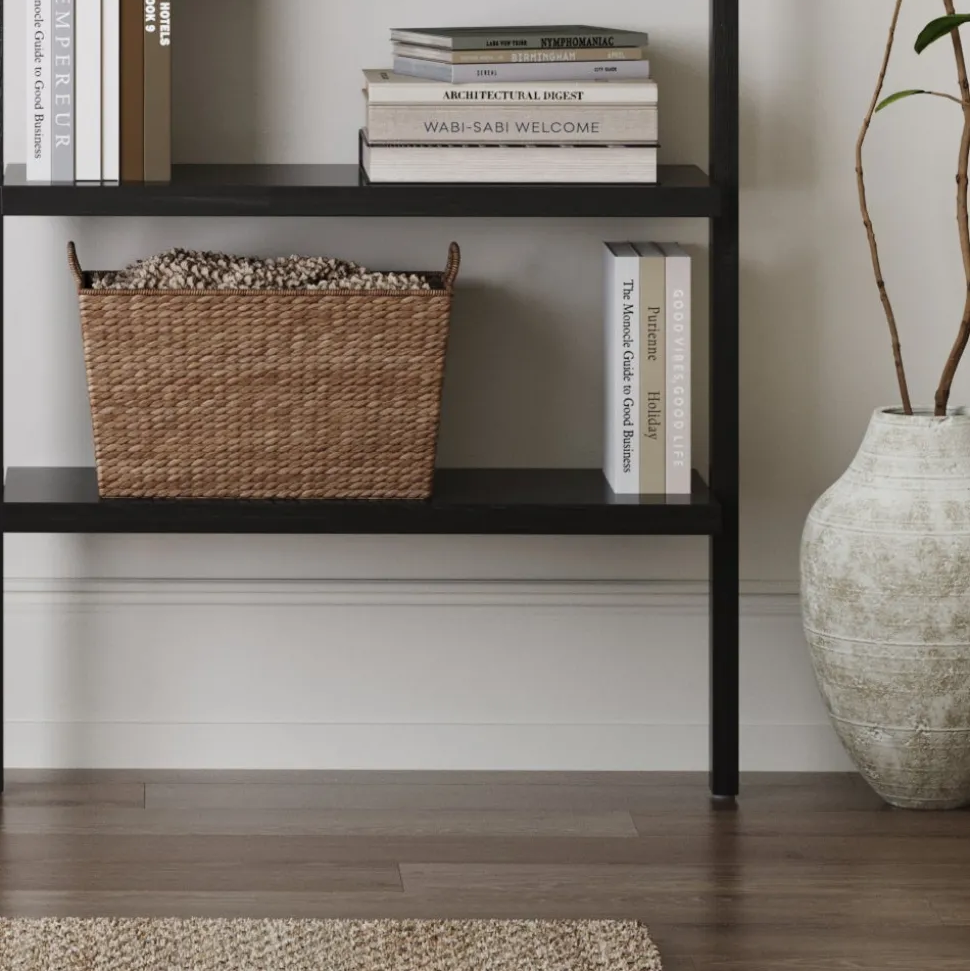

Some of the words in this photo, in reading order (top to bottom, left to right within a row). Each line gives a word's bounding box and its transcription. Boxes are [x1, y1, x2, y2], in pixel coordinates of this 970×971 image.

[144, 24, 156, 33] 9
[159, 2, 171, 46] HOTELS
[34, 31, 45, 63] Guide
[510, 51, 576, 63] BIRMINGHAM
[540, 36, 615, 48] NYMPHOMANIAC
[34, 66, 45, 77] to
[34, 80, 45, 110] Good
[442, 90, 541, 101] ARCHITECTURAL
[543, 90, 585, 101] DIGEST
[34, 113, 45, 159] Business
[423, 120, 510, 134] WABI-SABI
[515, 120, 600, 134] WELCOME
[623, 279, 634, 301] The
[623, 304, 634, 348] Monocle
[673, 289, 684, 333] GOOD
[647, 306, 660, 361] Purienne
[623, 350, 634, 382] Guide
[623, 385, 634, 395] to
[623, 397, 634, 427] Good
[643, 391, 661, 441] Holiday
[673, 386, 684, 429] GOOD
[623, 429, 634, 473] Business
[673, 435, 684, 467] LIFE
